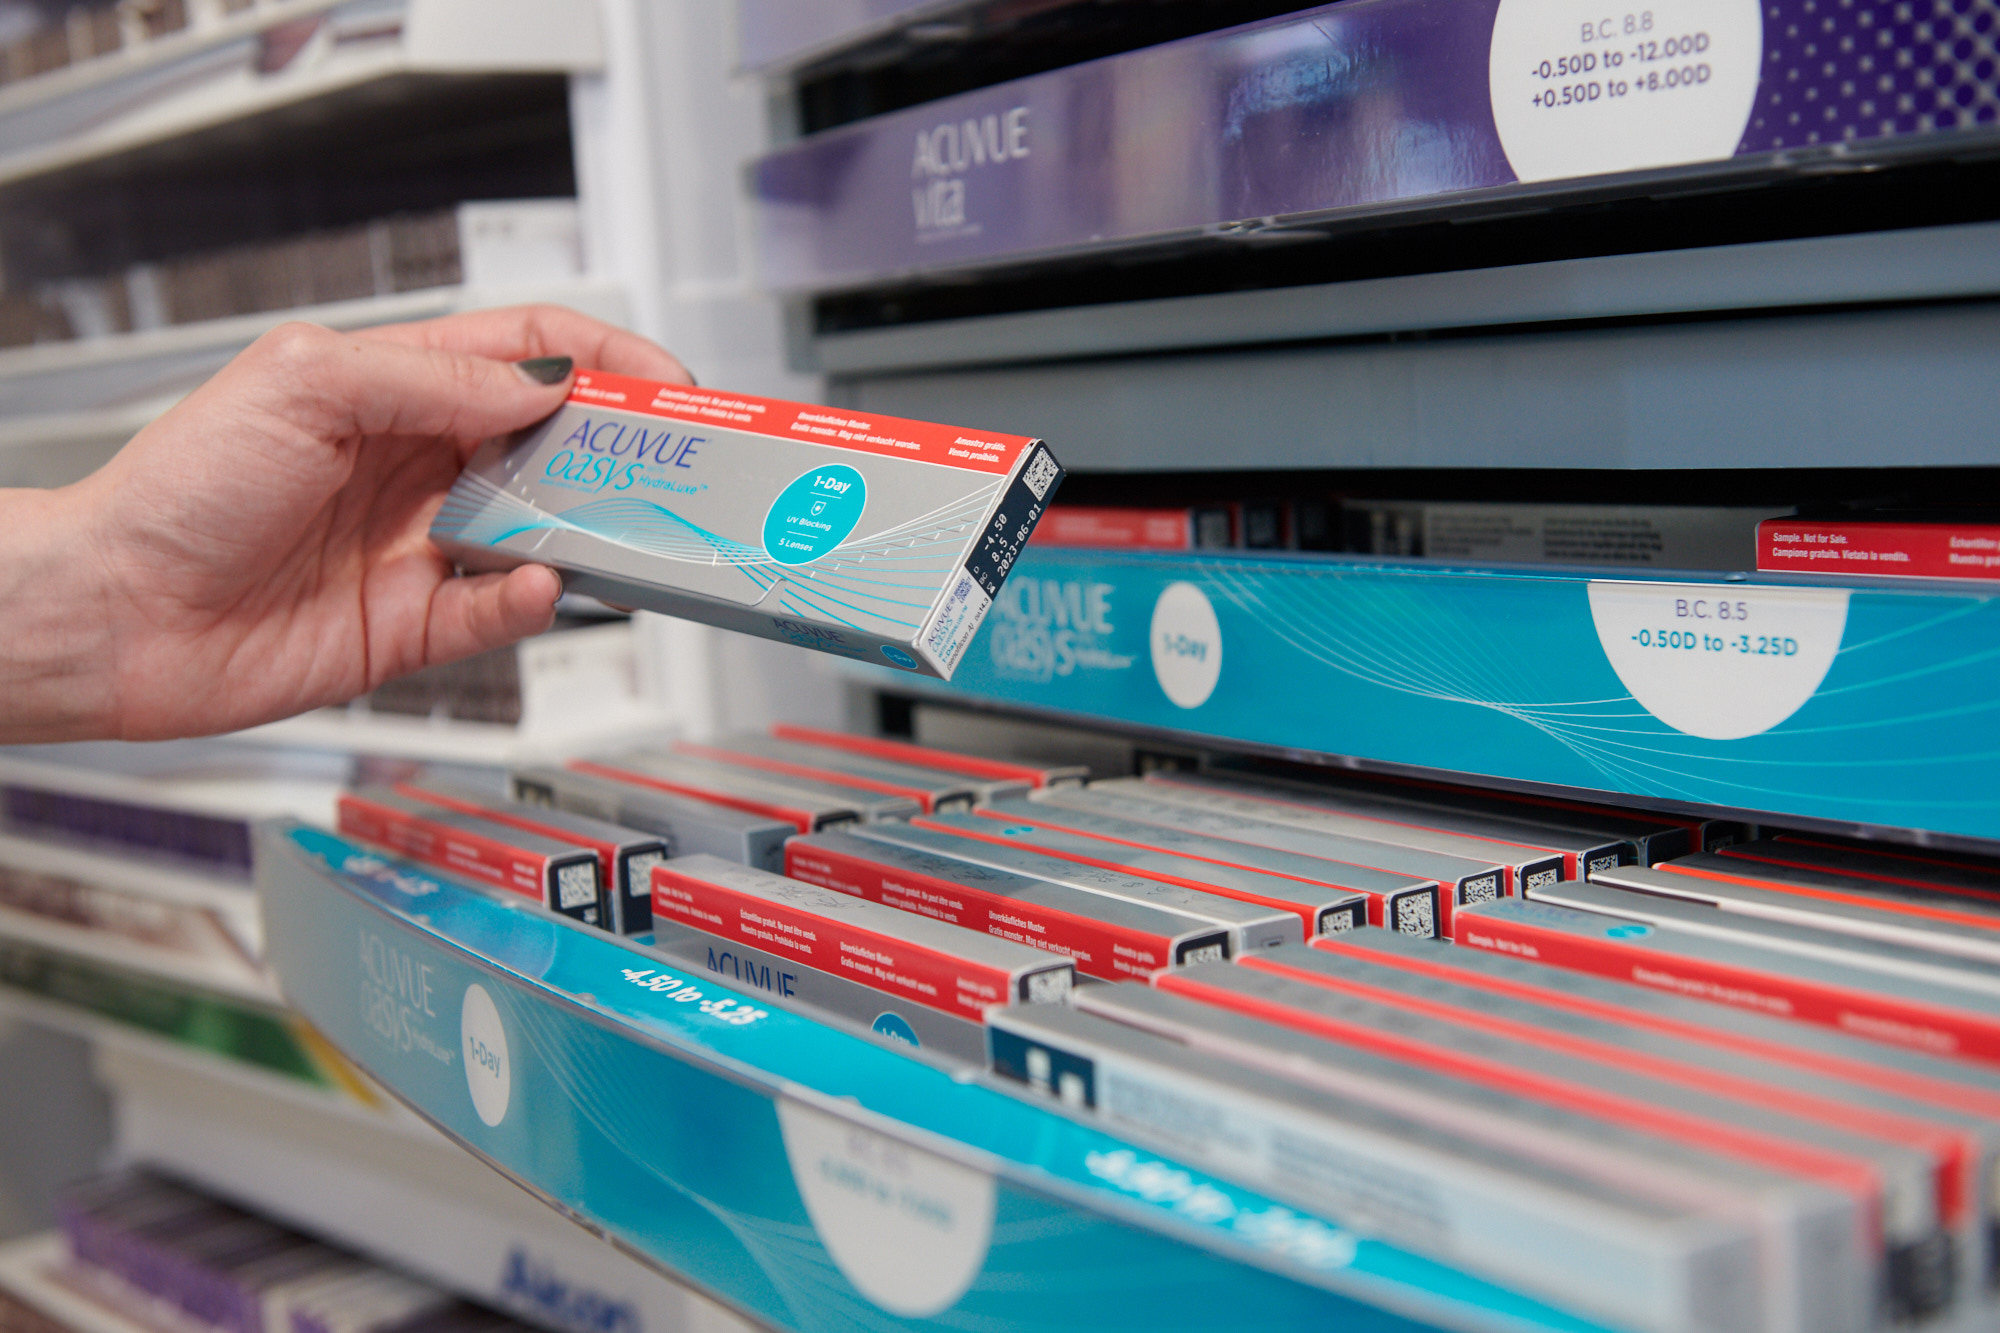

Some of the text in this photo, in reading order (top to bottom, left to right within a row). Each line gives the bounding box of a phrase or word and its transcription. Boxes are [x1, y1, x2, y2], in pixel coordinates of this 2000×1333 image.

[1581, 10, 1653, 42] B.C. 8.8
[1532, 32, 1710, 79] -0.50D to -12.00D
[1532, 63, 1711, 107] +0.50D to +8.00D
[563, 418, 707, 468] ACUVUE
[948, 447, 970, 458] Venda
[954, 436, 985, 448] Amostra
[814, 476, 851, 494] 1-Day
[799, 518, 832, 531] Blocking
[1773, 532, 1848, 544] Sample. Not for Sale.
[778, 538, 813, 552] 5 Lenses
[973, 513, 1007, 574] D -4.50
[997, 503, 1041, 577] 2023-06-01
[1772, 547, 1910, 561] Campione gratuito. Vietata la vendita.
[979, 537, 1008, 584] BC 8.5
[1676, 599, 1748, 621] B.C. 8.5
[1164, 633, 1208, 662] 1-Day
[1631, 629, 1798, 656] -0.50D to -3.25D
[989, 924, 1003, 937] Gratis
[1004, 930, 1025, 942] monster.
[1025, 934, 1037, 948] Mag
[1037, 939, 1047, 949] niet
[1048, 942, 1071, 956] verkocht
[1027, 920, 1046, 934] Muster.
[621, 969, 769, 1025] -4.50 to -5.25
[883, 1028, 909, 1045] 1-D
[470, 1036, 500, 1078] 1-Day
